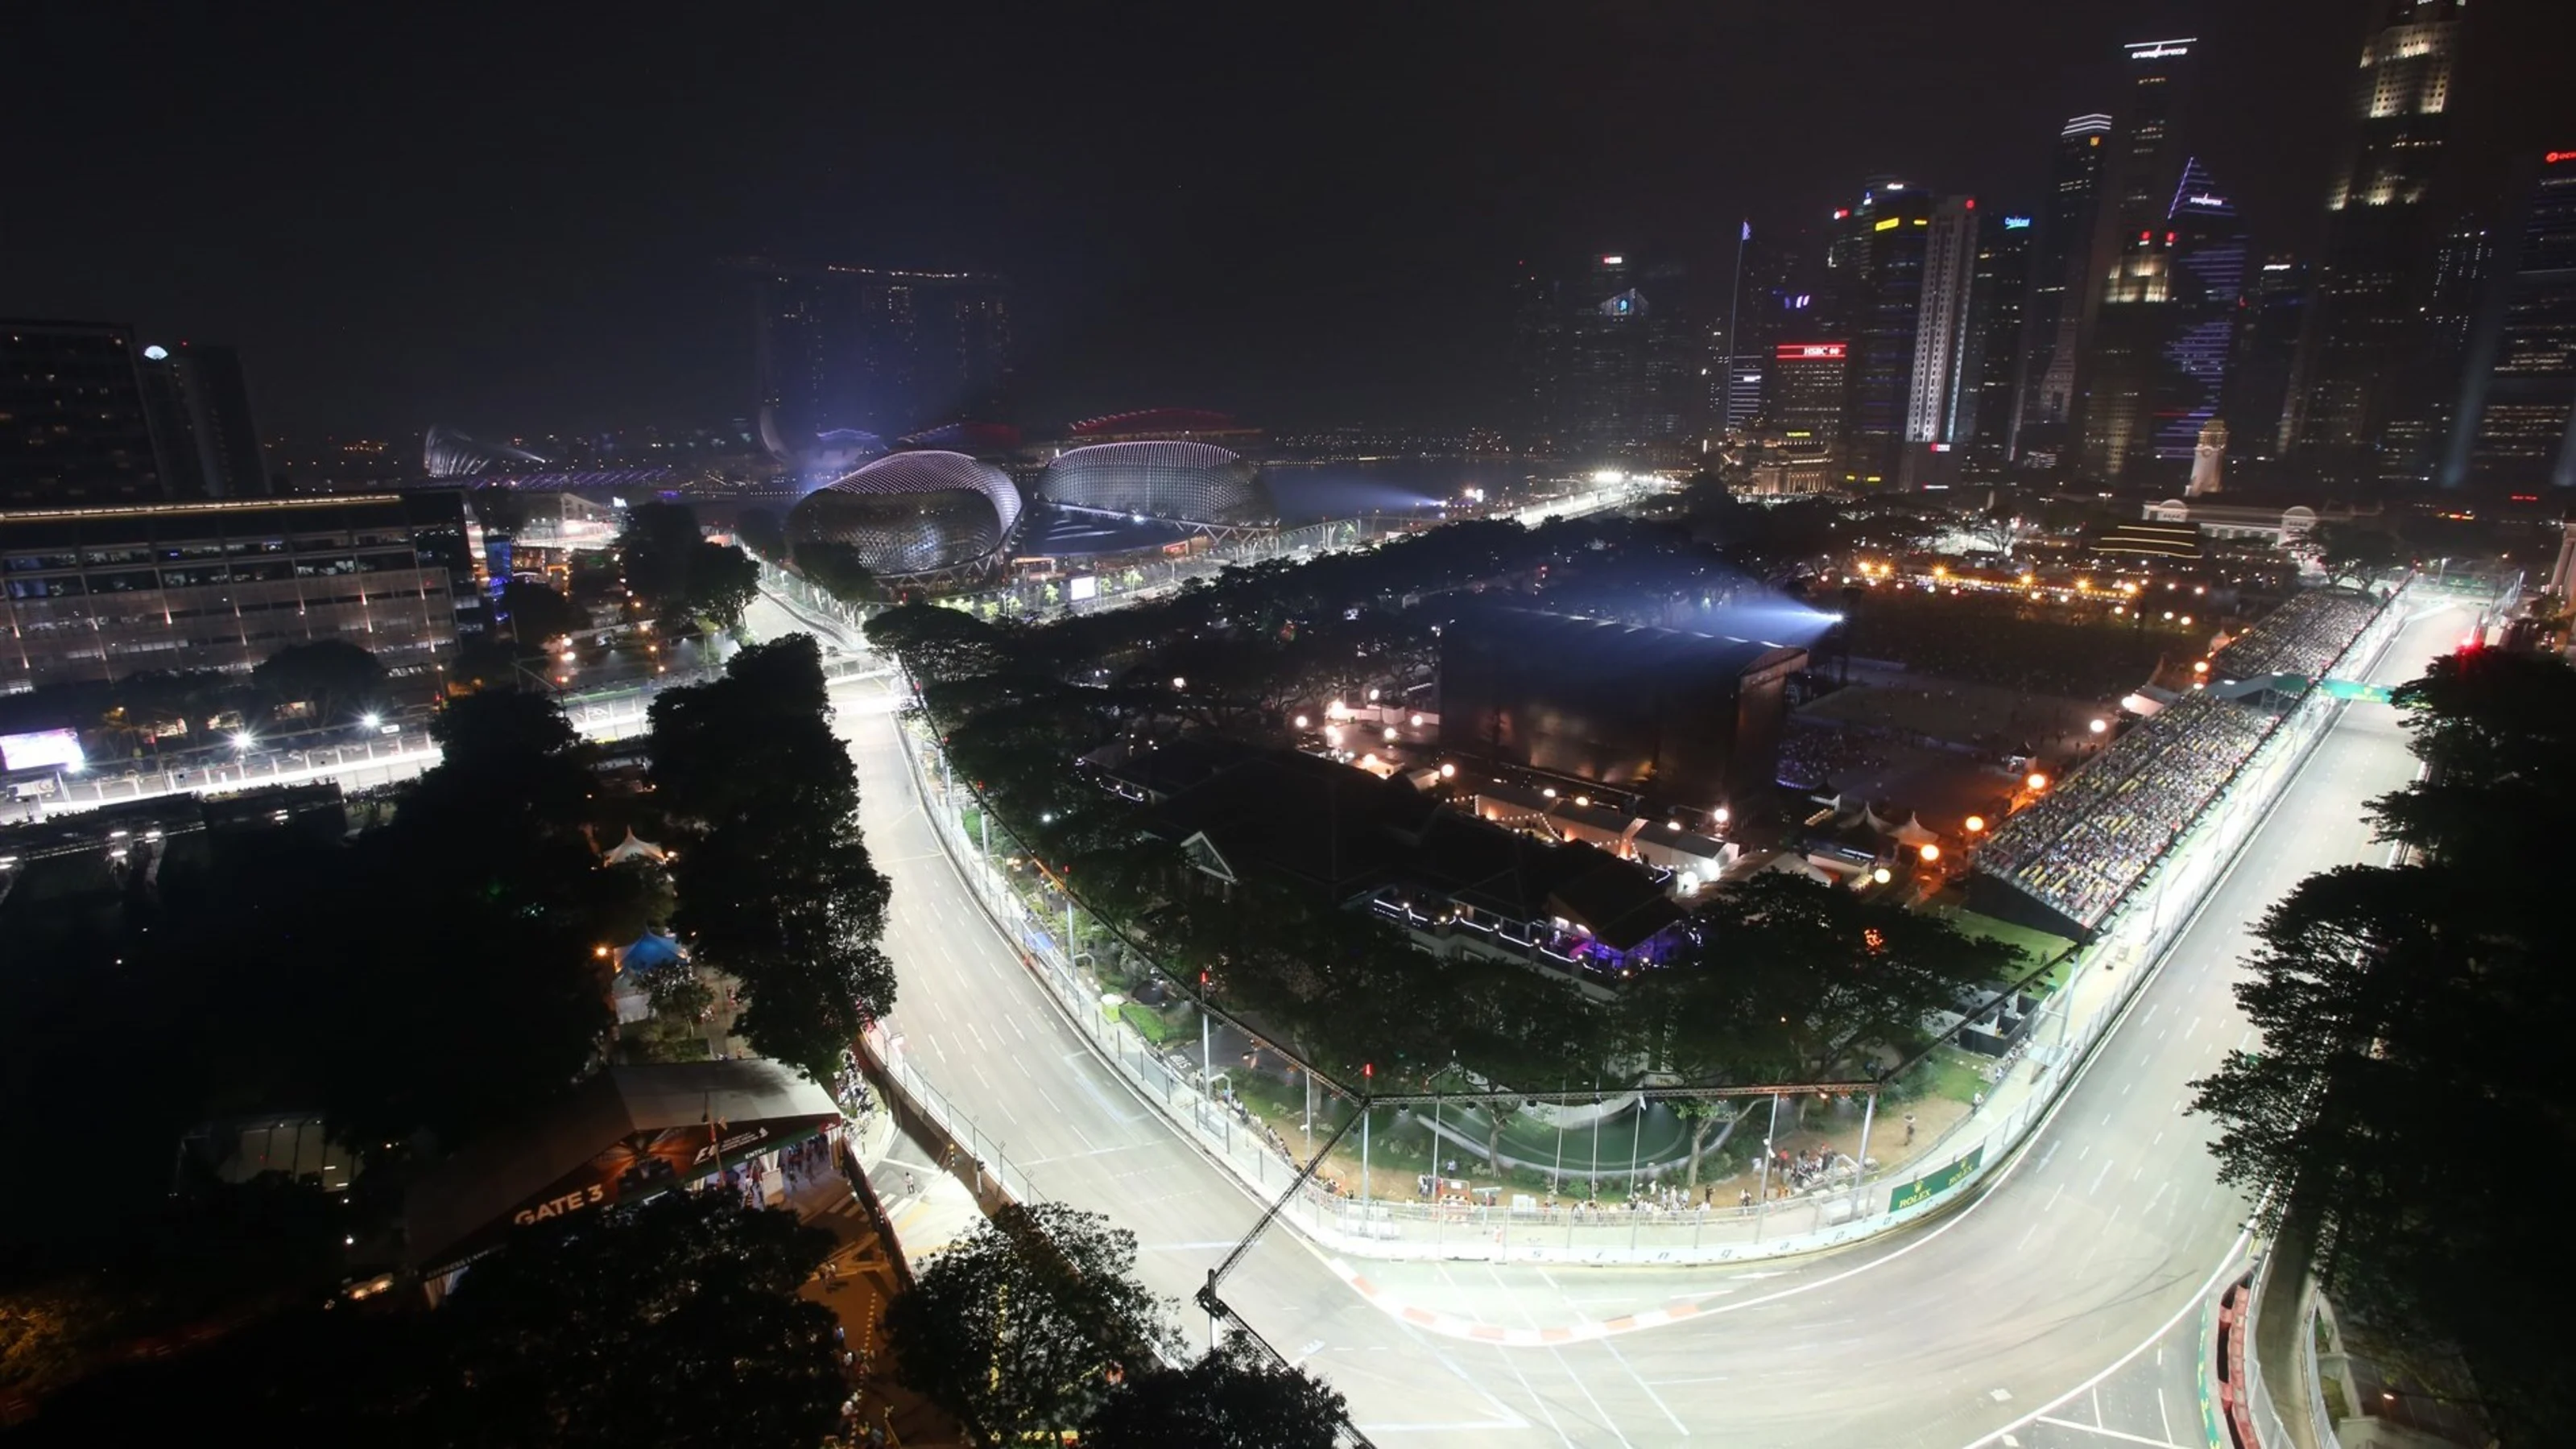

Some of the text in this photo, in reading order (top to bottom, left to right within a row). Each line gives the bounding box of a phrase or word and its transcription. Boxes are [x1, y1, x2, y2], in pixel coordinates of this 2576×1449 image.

[1804, 347, 1828, 356] HSBC
[745, 1147, 767, 1159] ENTRY
[1949, 1163, 1973, 1186] ROLEX
[514, 1191, 585, 1226] GATE
[587, 1183, 604, 1203] 3
[1898, 1187, 1932, 1208] ROLEX
